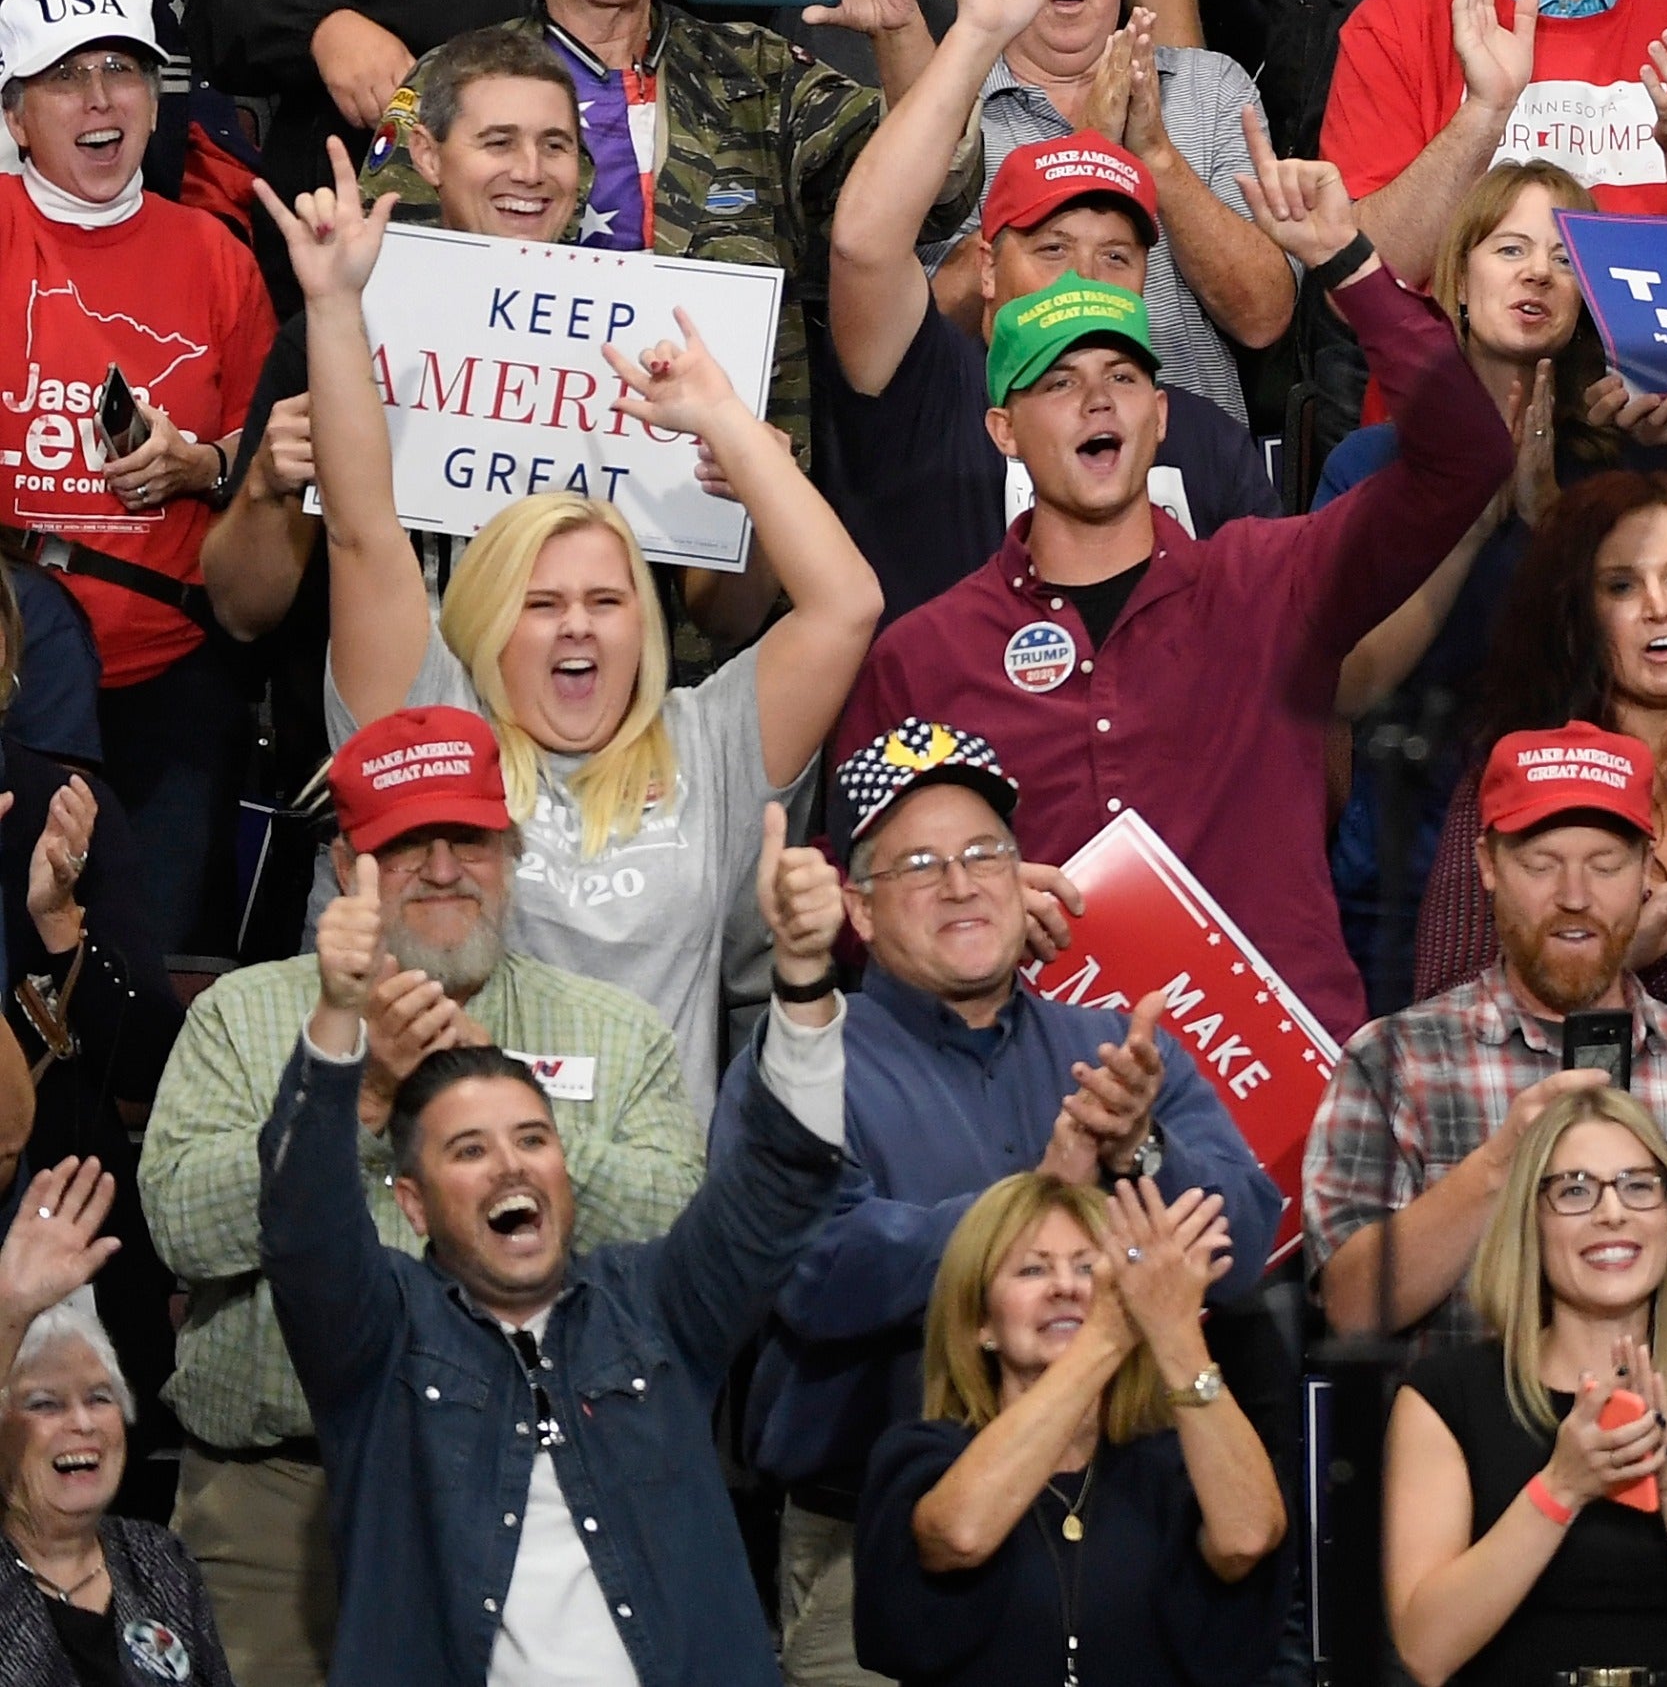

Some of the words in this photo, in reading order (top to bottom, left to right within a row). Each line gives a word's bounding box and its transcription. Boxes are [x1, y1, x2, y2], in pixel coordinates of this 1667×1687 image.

[1549, 123, 1653, 155] TRUMP
[1034, 150, 1079, 170] MAKE
[1080, 150, 1140, 185] AMERICA
[1045, 165, 1094, 181] GREAT
[1095, 166, 1136, 194] AGAIN
[1053, 290, 1082, 307] OUR
[489, 288, 636, 343] KEEP
[15, 475, 56, 493] FOR
[444, 447, 629, 498] GREAT
[1010, 648, 1068, 666] TRUMP
[1026, 667, 1056, 682] 2020
[362, 752, 404, 777] MAKE
[405, 741, 474, 762] AMERICA
[1517, 748, 1559, 767] MAKE
[1559, 748, 1634, 775] AMERICA
[372, 768, 421, 791] GREAT
[422, 759, 471, 778] AGAIN
[1526, 765, 1577, 783] GREAT
[1578, 767, 1626, 789] AGAIN
[1160, 972, 1273, 1101] MAKE
